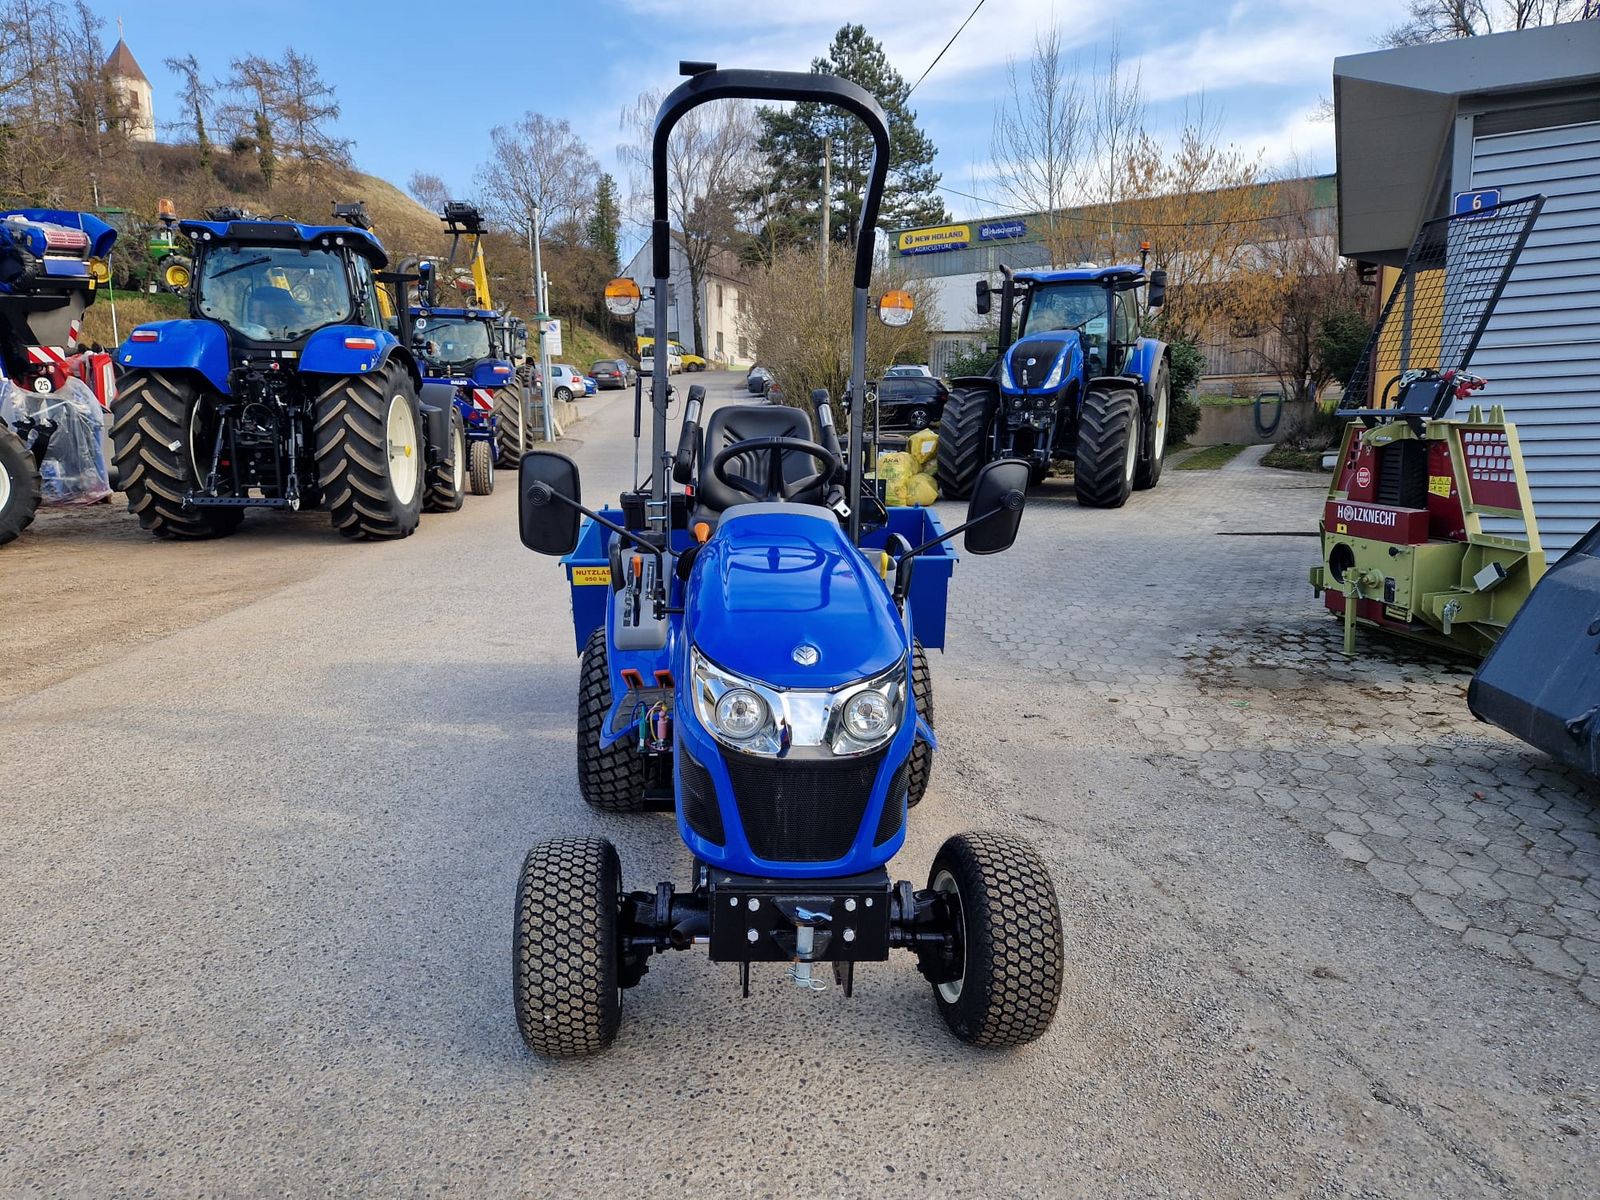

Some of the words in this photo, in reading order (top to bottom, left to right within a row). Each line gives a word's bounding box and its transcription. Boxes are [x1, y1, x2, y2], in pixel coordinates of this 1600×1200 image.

[1472, 194, 1482, 210] 6
[988, 225, 1022, 235] Husqvarna
[914, 234, 931, 243] NEW
[931, 230, 964, 241] HOLLAND
[914, 243, 952, 253] AGRICULTURE
[37, 380, 49, 391] 25
[1337, 505, 1397, 527] HOLZKNECHT
